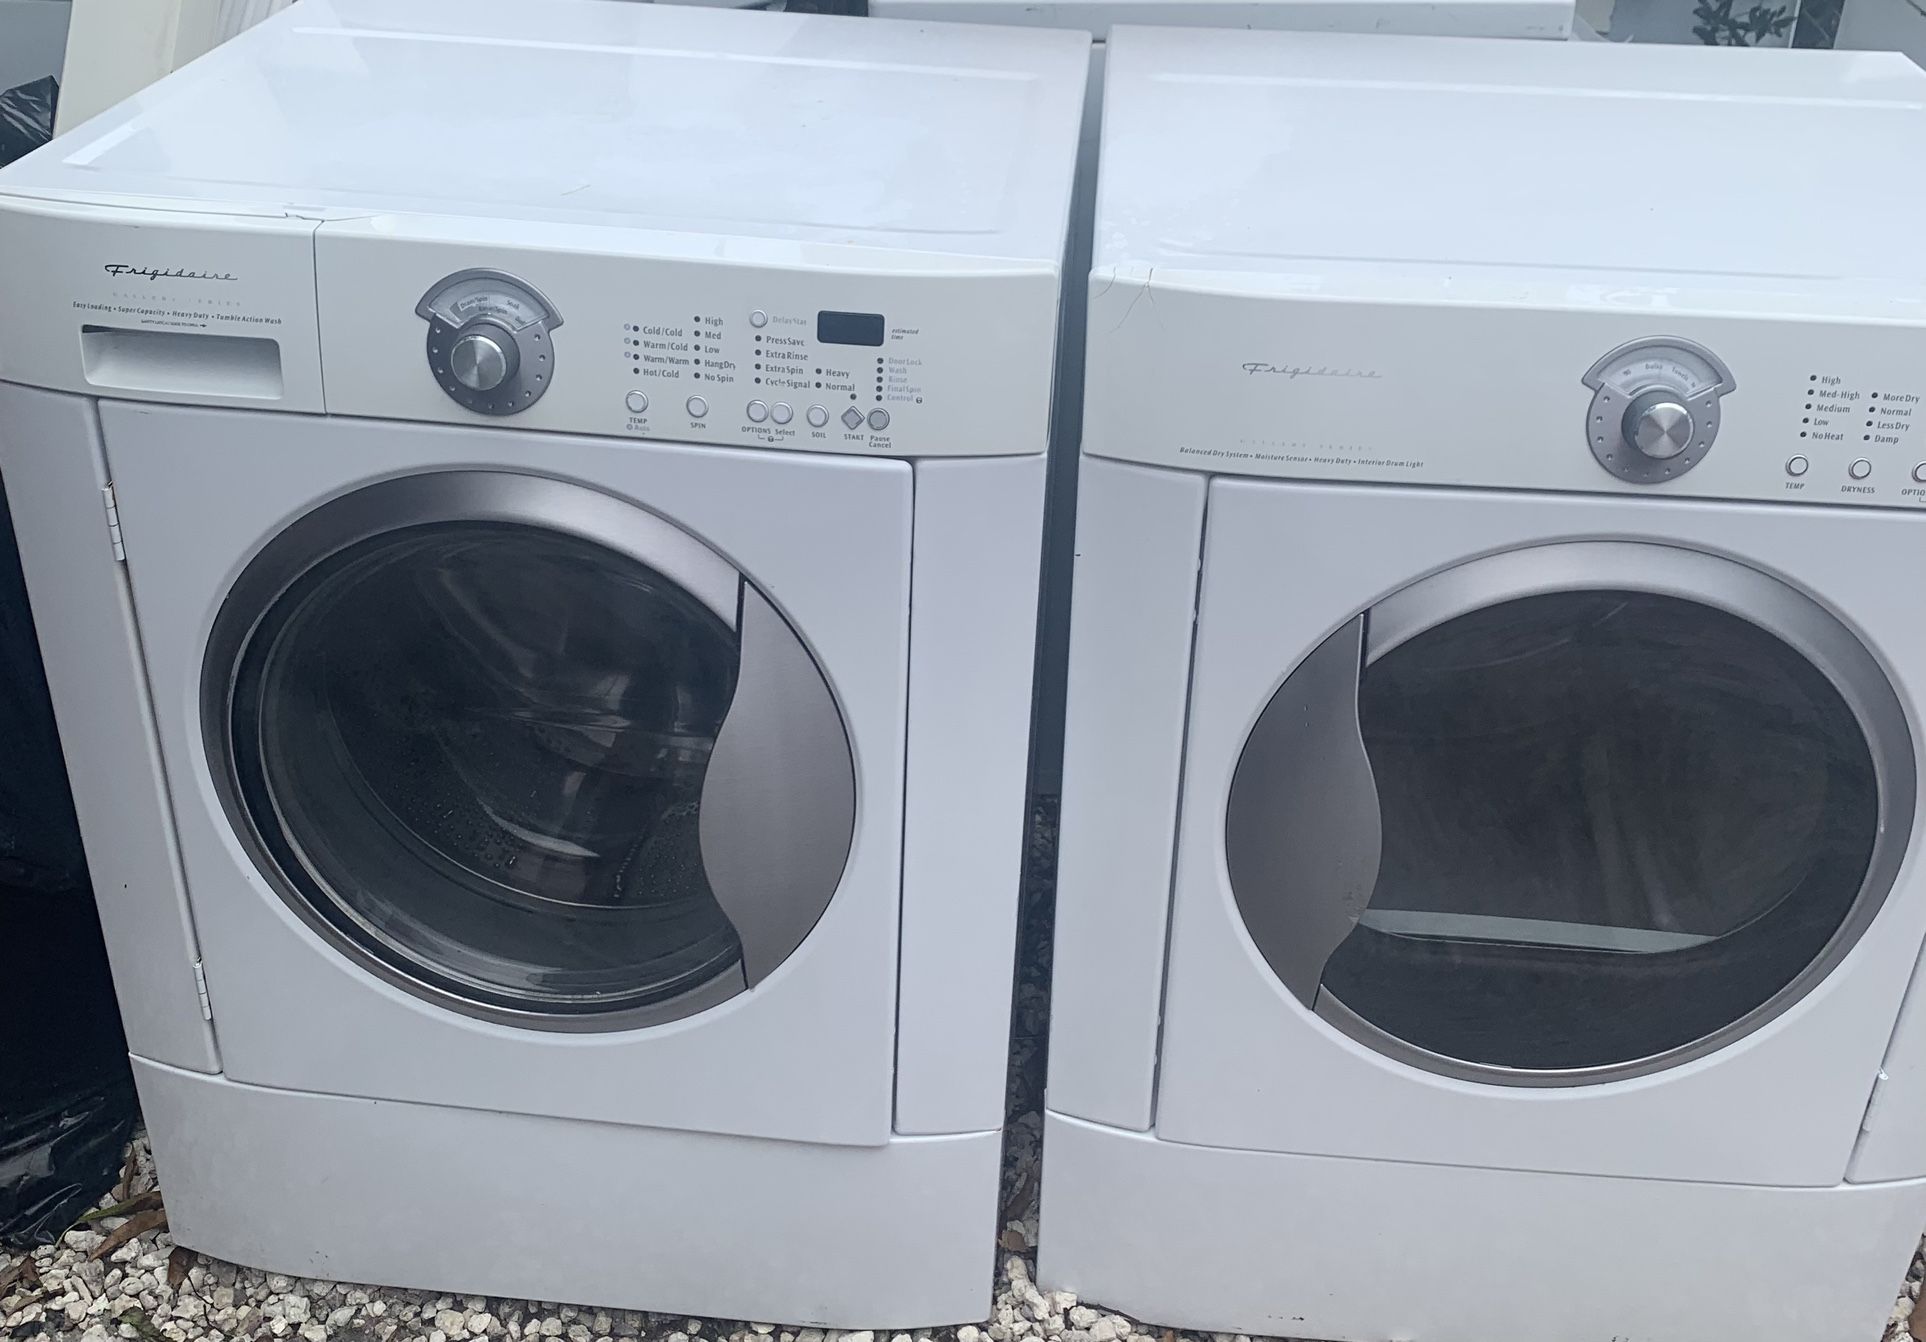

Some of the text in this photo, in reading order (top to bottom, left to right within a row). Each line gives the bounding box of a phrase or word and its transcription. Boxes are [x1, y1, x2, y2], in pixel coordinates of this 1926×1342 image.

[104, 264, 238, 280] Frigidaire
[137, 307, 165, 316] Capacity
[172, 311, 192, 319] Heavy
[193, 312, 209, 320] Duty
[705, 317, 723, 327] High
[643, 326, 683, 337] Cold/Cold
[705, 331, 721, 339] Med
[643, 340, 689, 351] Warm/Cold
[704, 345, 720, 353] Low
[643, 355, 690, 365] Warm/Warm
[643, 368, 680, 378] Hot/Cold
[826, 368, 850, 378] Heavy
[1242, 362, 1382, 379] Frigidaire
[1821, 376, 1841, 386] High
[826, 382, 855, 392] Normal
[1819, 390, 1860, 401] Med-High
[1816, 404, 1850, 413] Medium
[1880, 407, 1912, 416] Normal
[1814, 418, 1829, 426] Low
[741, 426, 771, 435] OPTIONS
[811, 431, 827, 439] SOIL
[844, 433, 864, 441] START
[1874, 435, 1899, 444] Damp
[1180, 447, 1212, 455] Balanced
[1226, 451, 1248, 459] System
[1255, 453, 1284, 461] Moisture
[1841, 485, 1875, 493] DRYNESS
